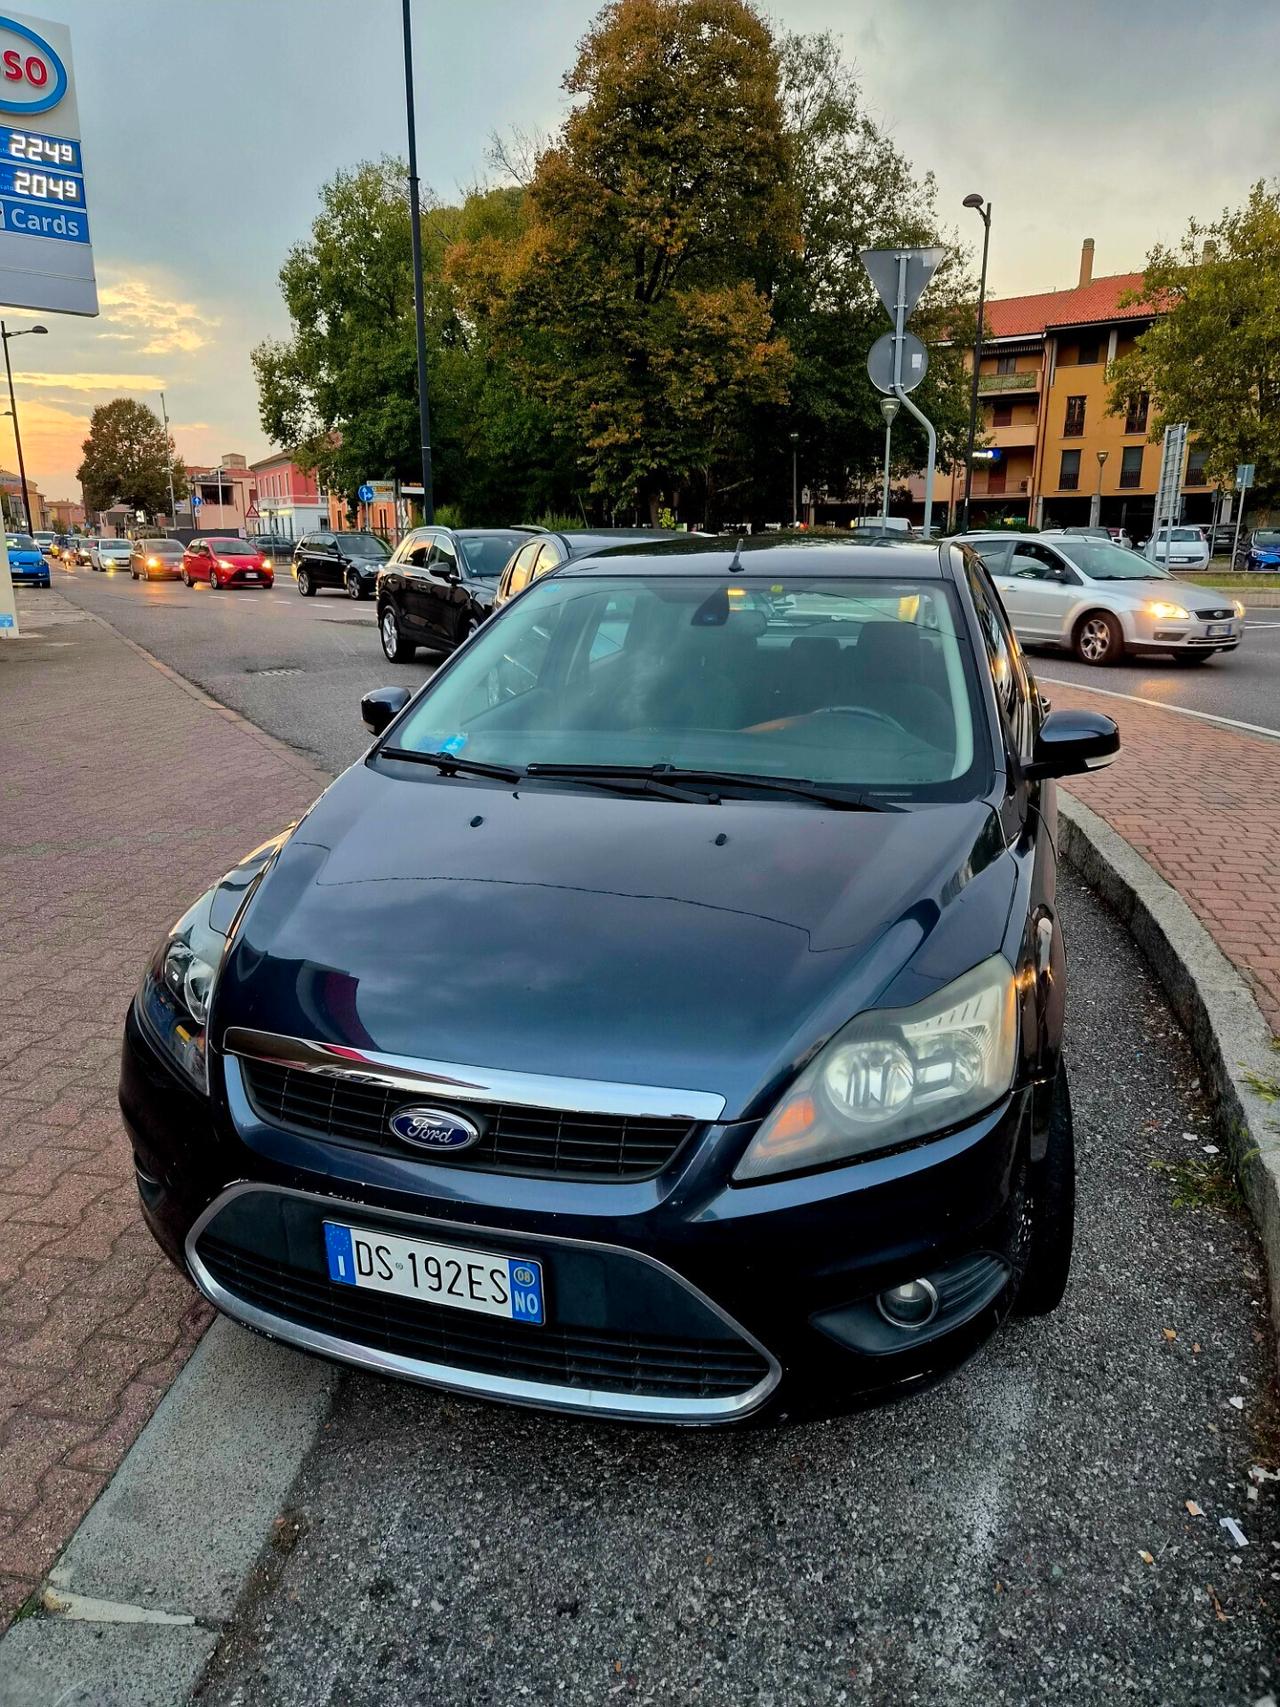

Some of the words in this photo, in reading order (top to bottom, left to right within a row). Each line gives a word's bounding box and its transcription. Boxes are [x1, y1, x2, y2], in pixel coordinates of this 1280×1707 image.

[0, 49, 48, 87] SO
[10, 134, 73, 165] 2249
[14, 170, 77, 201] 2049
[11, 208, 79, 237] Cards
[407, 1117, 454, 1143] Ford
[514, 1290, 539, 1315] NO
